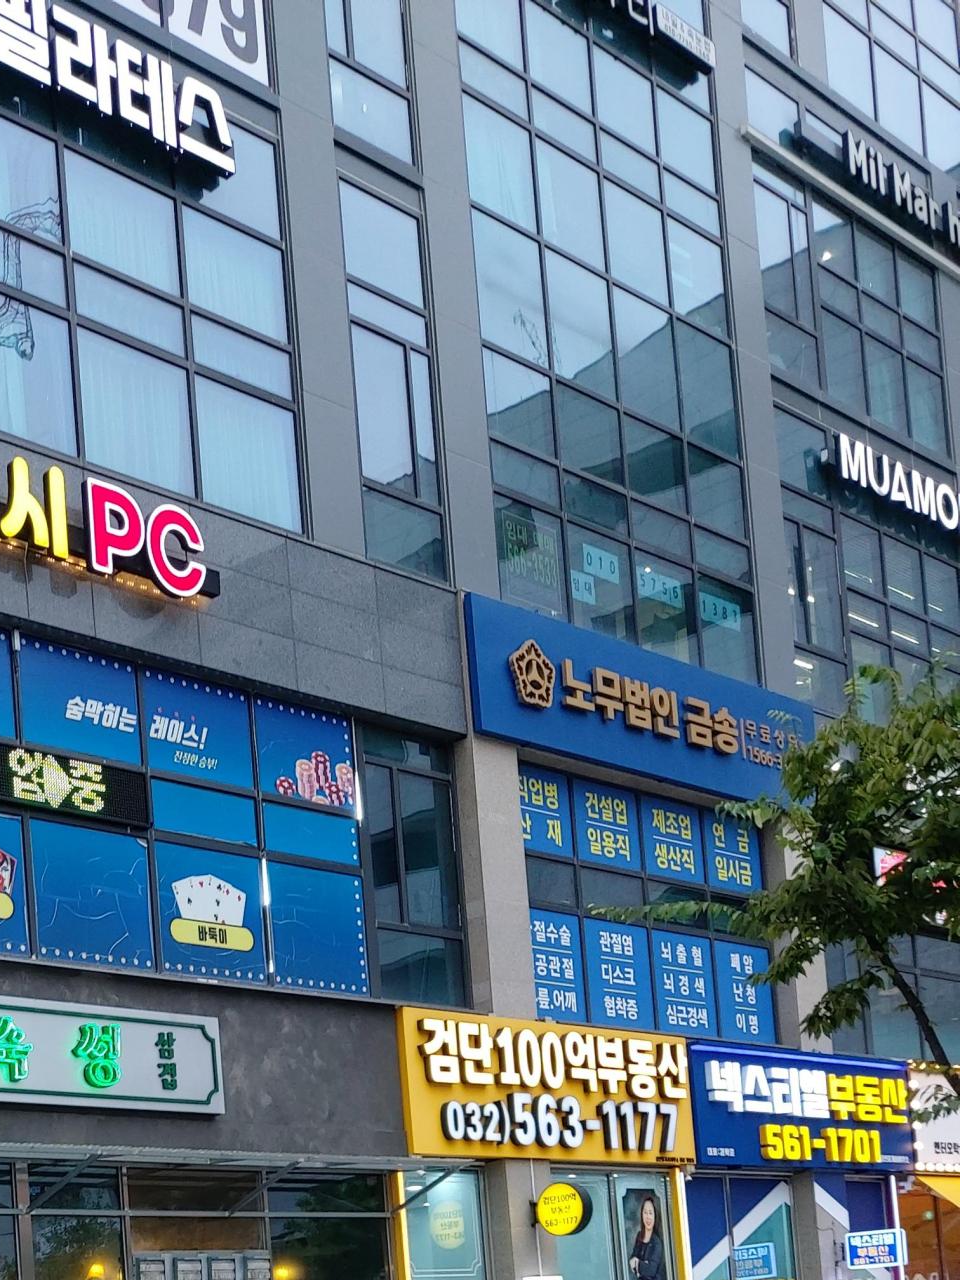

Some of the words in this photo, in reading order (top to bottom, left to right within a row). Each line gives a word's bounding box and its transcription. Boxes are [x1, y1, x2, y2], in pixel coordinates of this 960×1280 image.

[839, 432, 960, 531] MUAMO
[82, 477, 206, 597] PC
[585, 552, 616, 575] 010
[561, 659, 681, 739] 노무법인
[65, 696, 137, 733] 숨막히는
[149, 713, 208, 750] 레이스!
[585, 791, 628, 826] 건설업
[651, 807, 693, 841] 제조업
[587, 827, 631, 862] 일용직
[654, 842, 695, 875] 생산직
[714, 856, 753, 887] 일시금
[197, 924, 228, 946] 바둑이
[530, 920, 572, 947] 절수술
[599, 930, 634, 957] 관절염
[535, 953, 575, 980] 공관절
[660, 941, 703, 968] 뇌출혈
[601, 962, 637, 987] 디스크
[662, 975, 706, 998] 뇌경색
[535, 987, 578, 1014] 릎.어깨
[603, 995, 639, 1021] 협착증
[666, 1005, 709, 1029] 심근경색
[735, 1013, 760, 1035] 이명
[417, 1017, 689, 1099] 검단100억부동산
[441, 1091, 678, 1152] 032)563-1177
[760, 1124, 882, 1163] 561-1701
[545, 1216, 578, 1228] 563-1177
